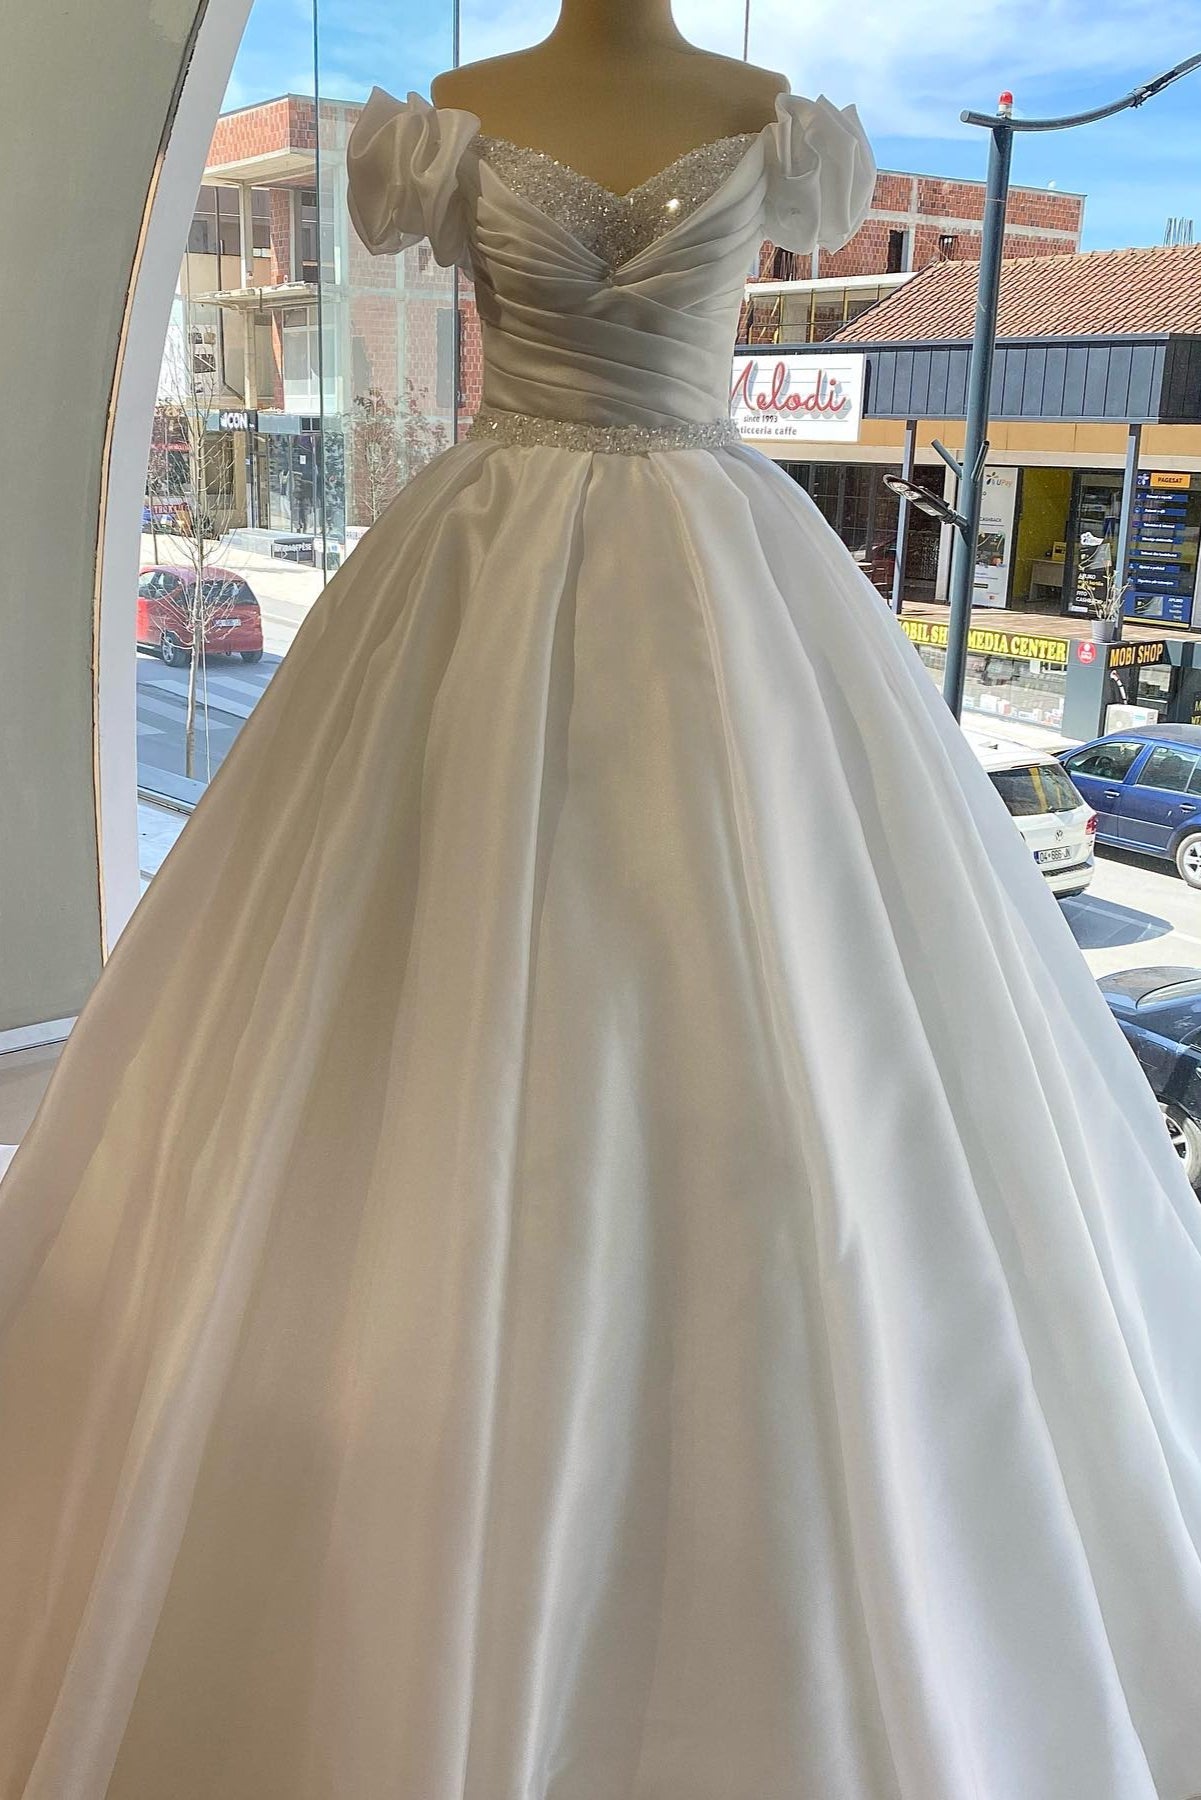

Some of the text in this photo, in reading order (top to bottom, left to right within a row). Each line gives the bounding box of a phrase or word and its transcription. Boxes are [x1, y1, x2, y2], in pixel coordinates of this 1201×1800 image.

[743, 414, 778, 423] since 1993
[774, 426, 797, 436] caffe
[1157, 476, 1183, 484] PAGESAT
[899, 621, 929, 641] OBIL
[968, 630, 1009, 653] MEDIA
[1011, 636, 1067, 661] CENTER
[1109, 643, 1164, 668] MOBI SHOP
